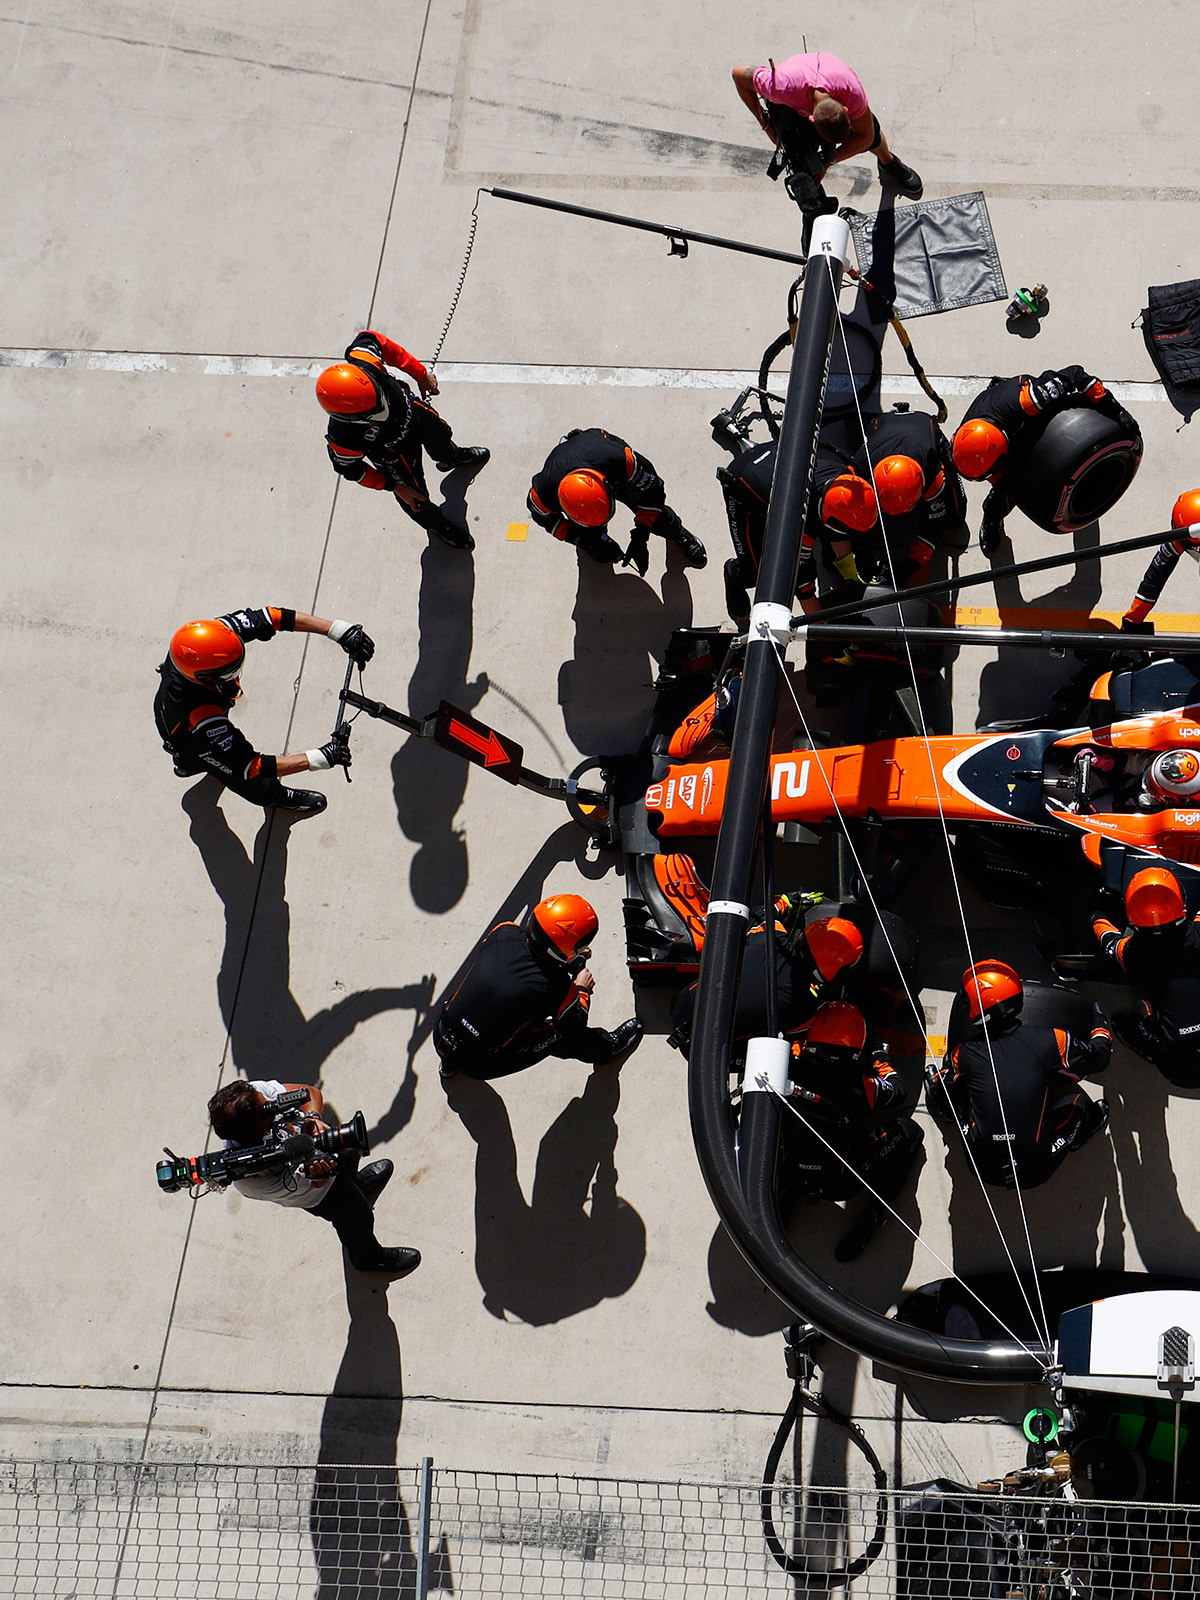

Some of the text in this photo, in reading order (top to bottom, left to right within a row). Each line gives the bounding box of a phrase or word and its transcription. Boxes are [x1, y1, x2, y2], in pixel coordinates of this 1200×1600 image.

[682, 775, 695, 802] SAP
[771, 759, 811, 801] 2
[666, 780, 676, 809] PIRELLI
[991, 822, 1070, 838] RICHARD MILLE
[992, 1133, 1016, 1141] sparco
